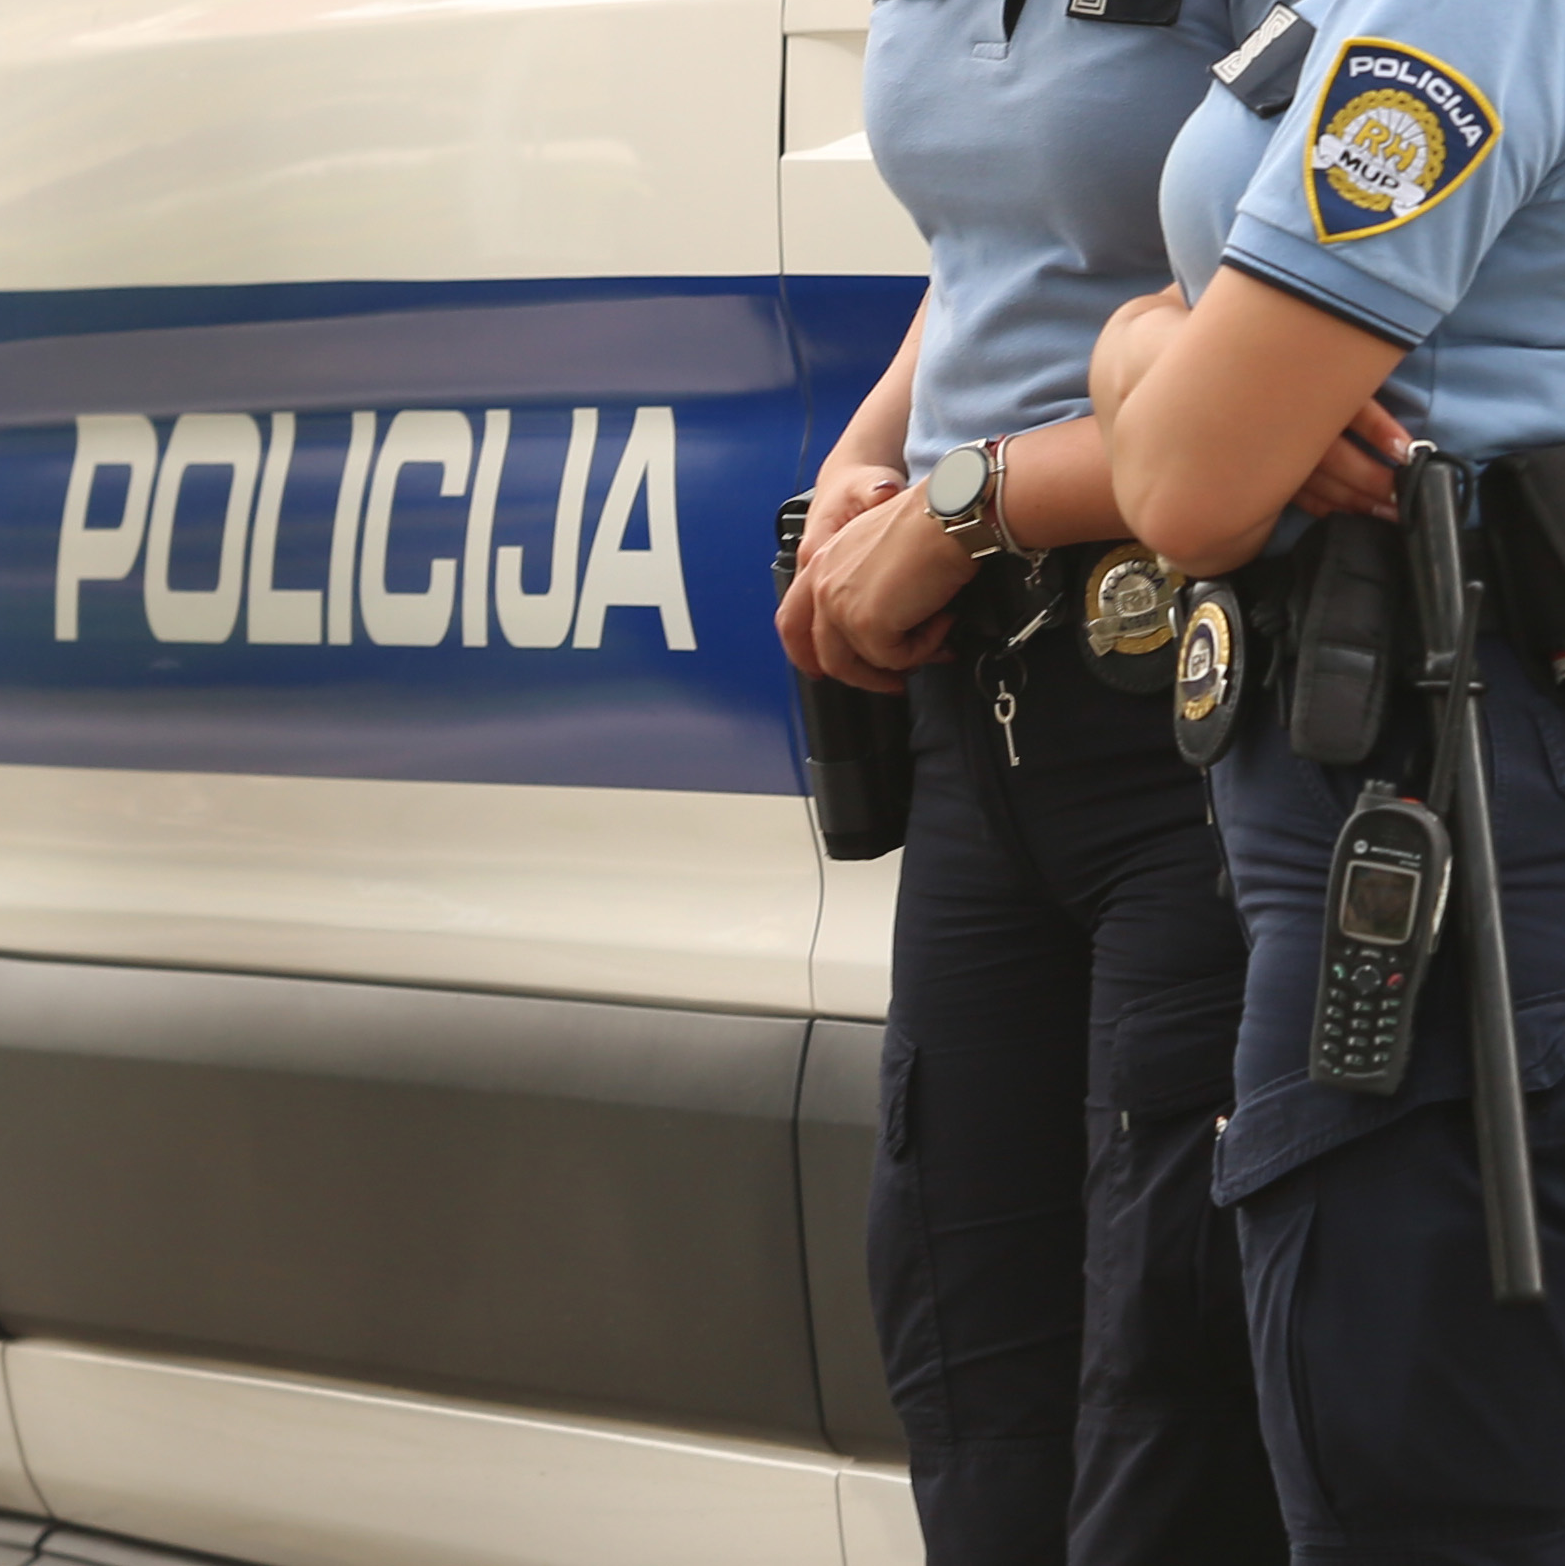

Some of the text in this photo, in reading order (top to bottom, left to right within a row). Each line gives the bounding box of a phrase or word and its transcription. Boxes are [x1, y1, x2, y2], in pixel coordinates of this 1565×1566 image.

[1349, 56, 1483, 148] POLICIJA
[1339, 150, 1400, 189] MUP
[1354, 118, 1418, 182] RH
[55, 406, 697, 651] POLICIJA
